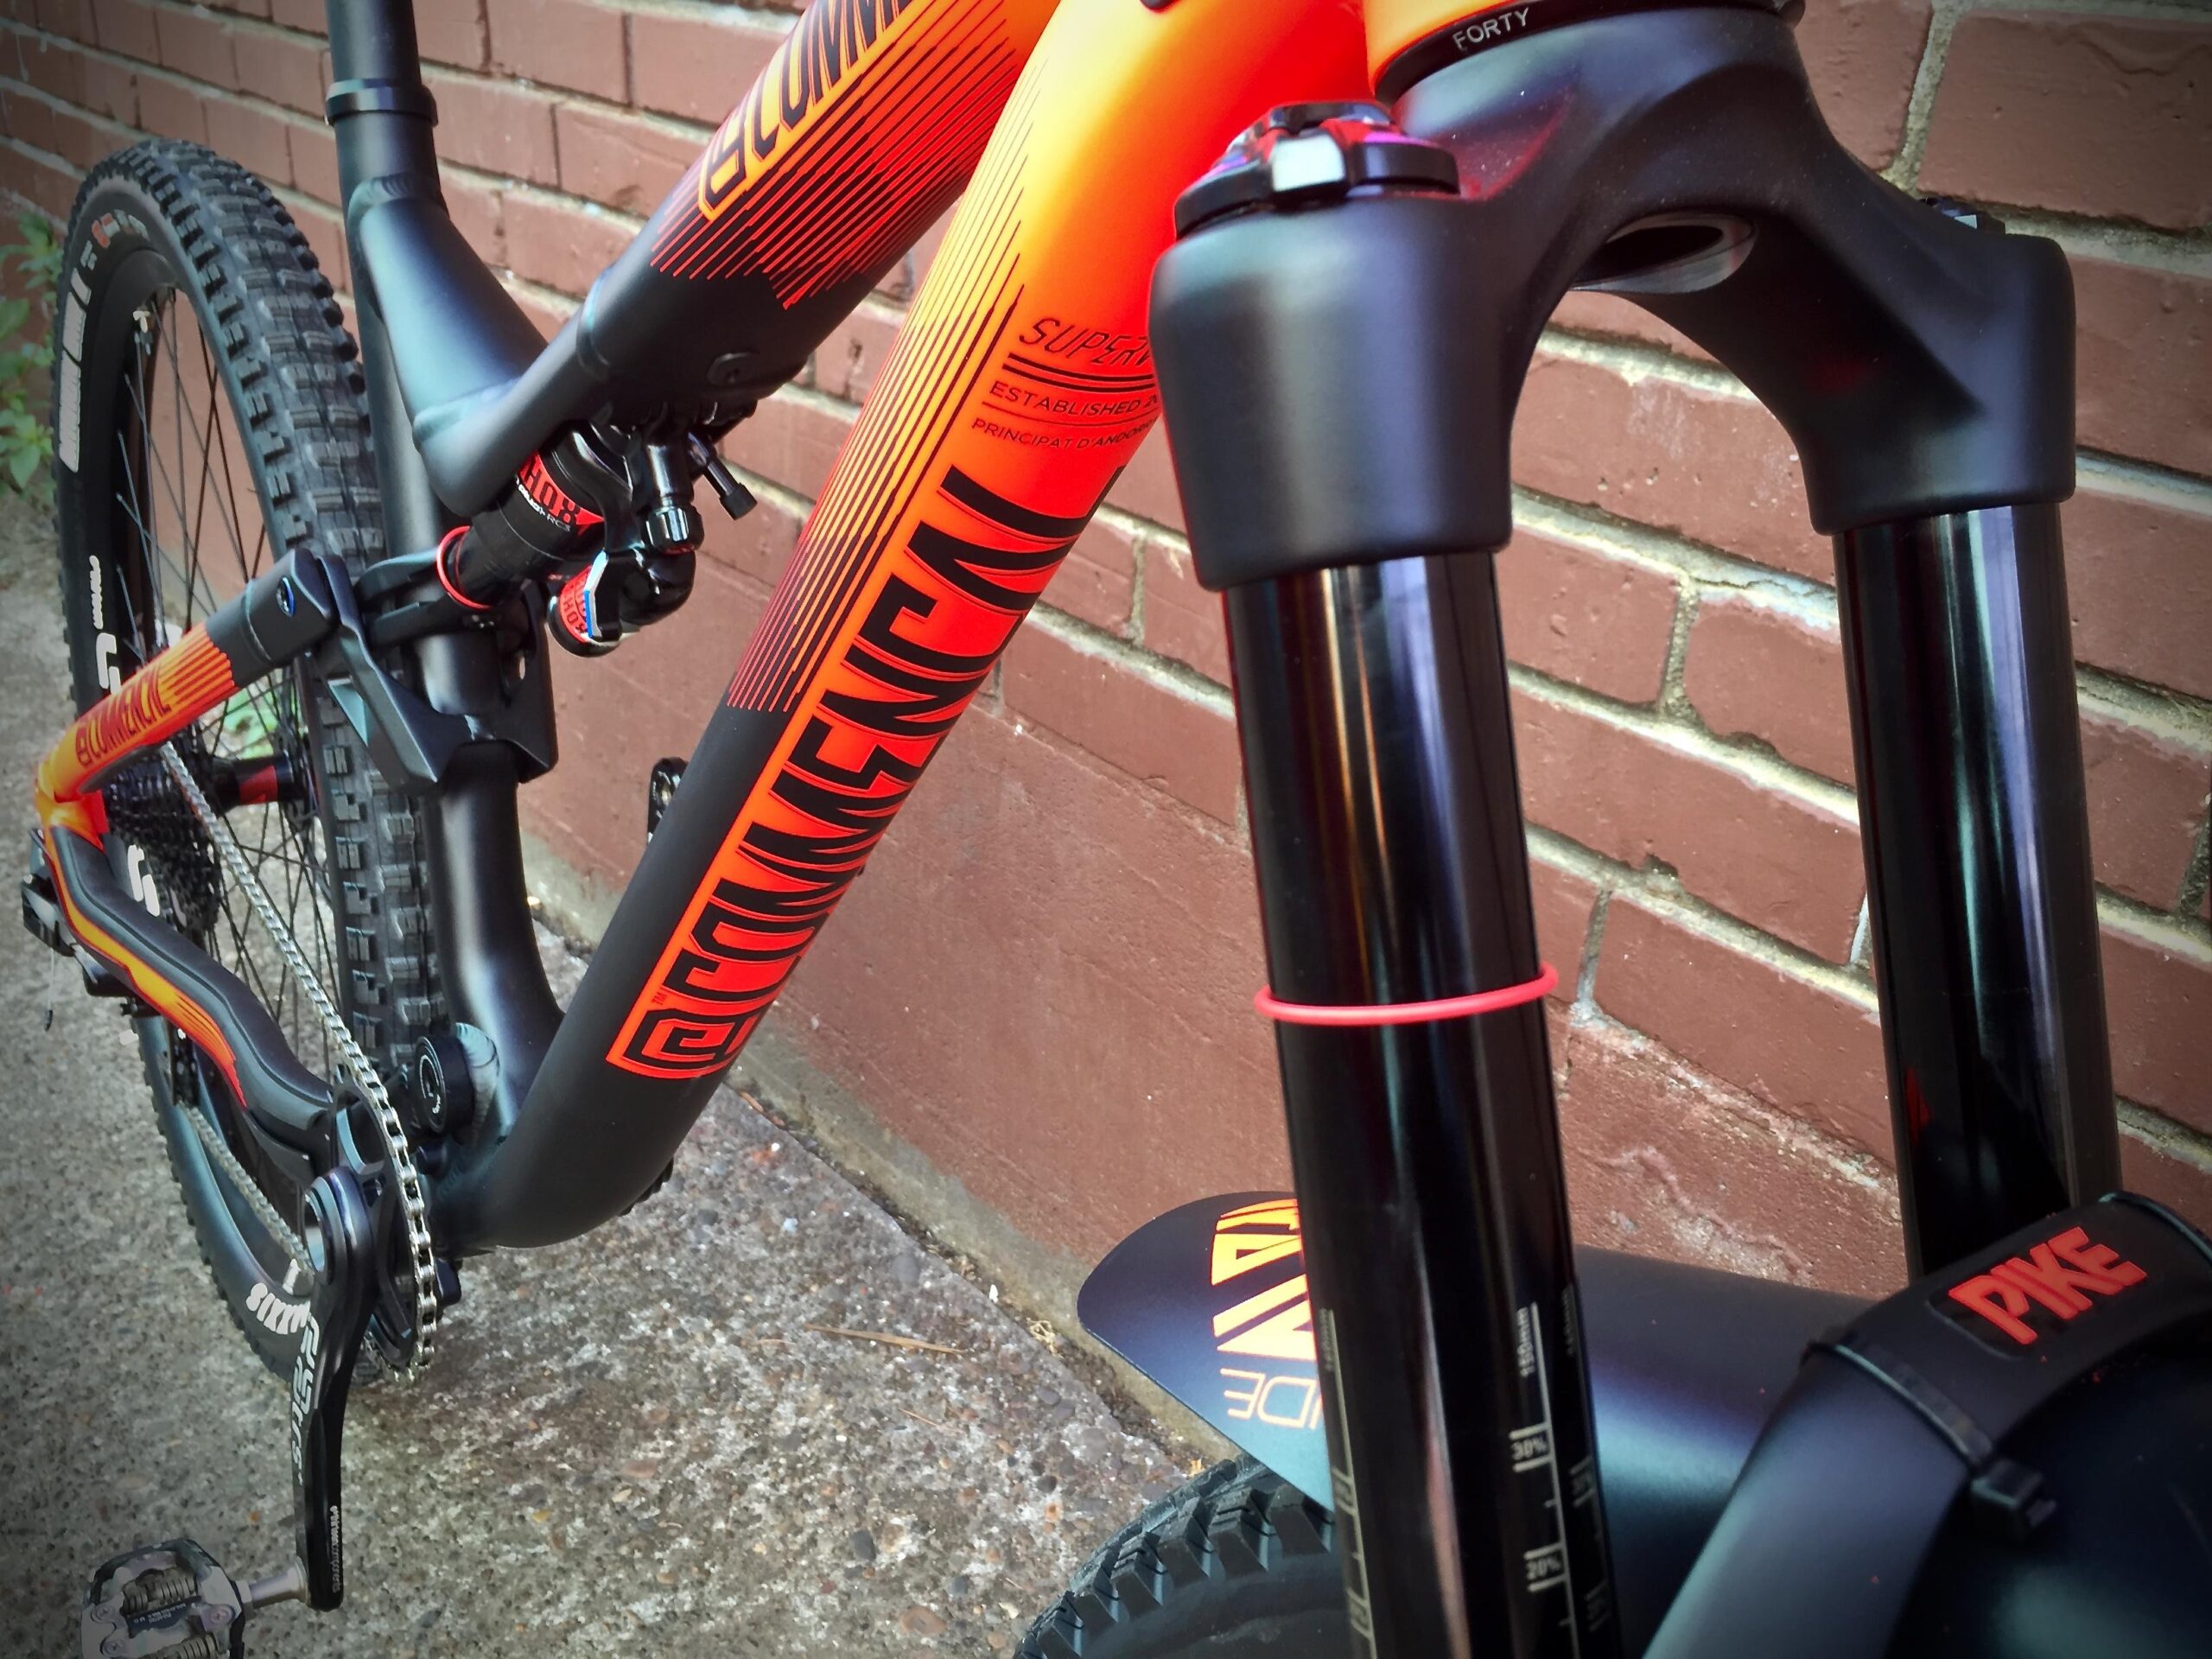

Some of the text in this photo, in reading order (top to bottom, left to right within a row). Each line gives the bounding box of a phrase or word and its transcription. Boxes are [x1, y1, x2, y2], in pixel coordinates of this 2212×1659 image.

[1452, 7, 1529, 51] FORTY
[989, 380, 1141, 416] ESTABLISHED
[971, 417, 1073, 448] PRINCIPAT
[1948, 1226, 2147, 1345] PIKE
